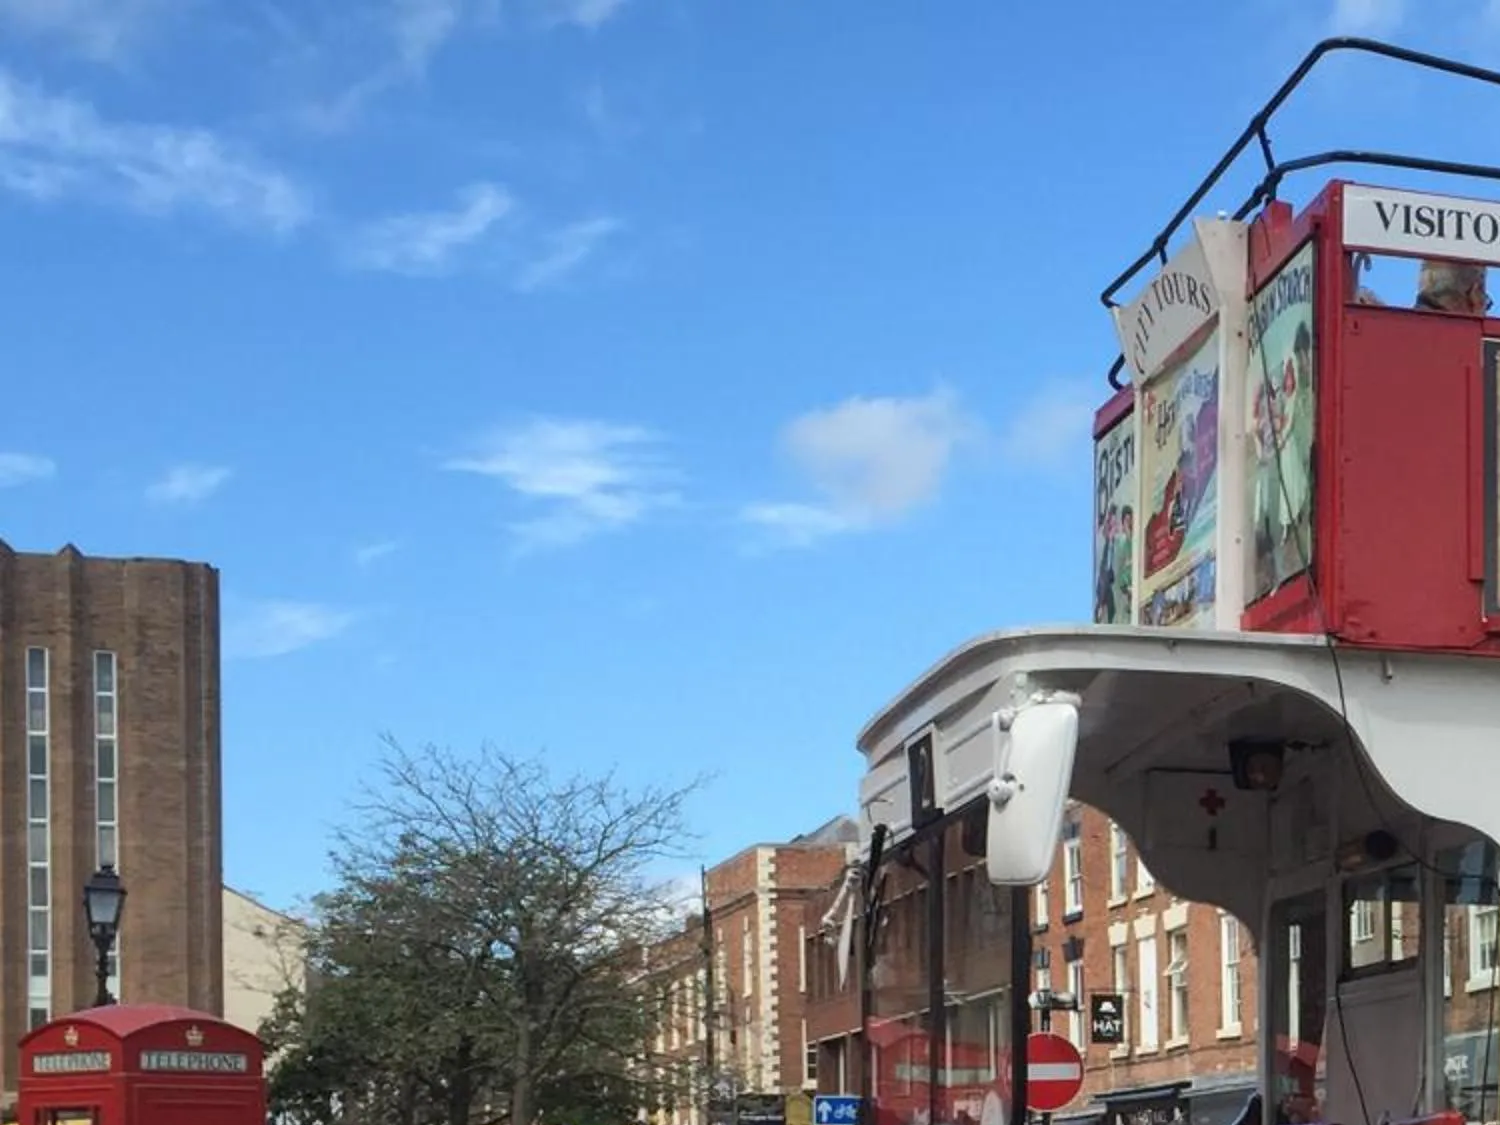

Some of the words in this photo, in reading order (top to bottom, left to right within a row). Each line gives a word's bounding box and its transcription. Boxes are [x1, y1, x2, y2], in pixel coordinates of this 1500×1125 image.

[1152, 271, 1211, 315] TOURS
[1094, 1020, 1121, 1033] HAT
[144, 1052, 243, 1071] TELEPHONE
